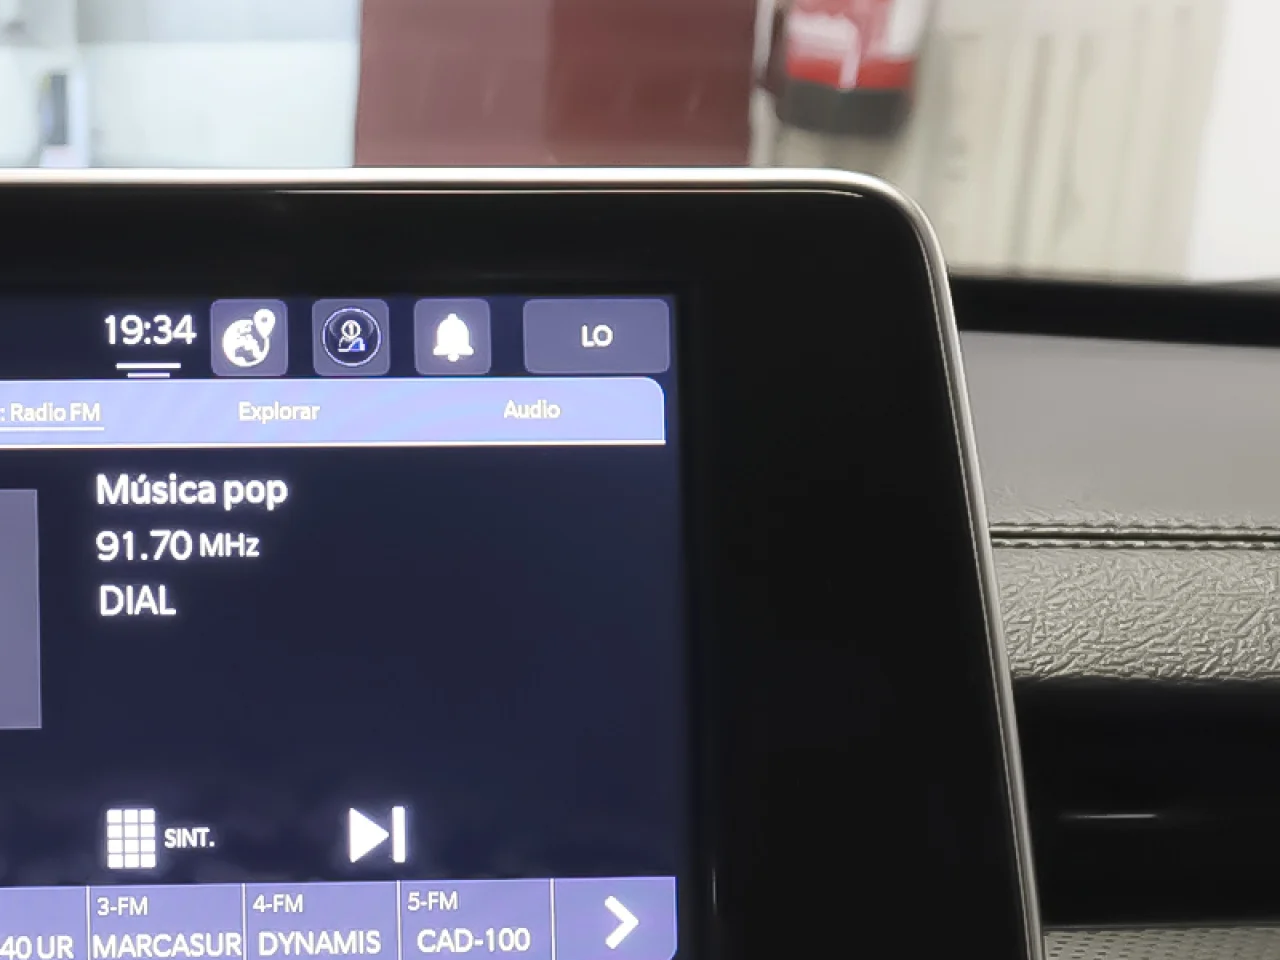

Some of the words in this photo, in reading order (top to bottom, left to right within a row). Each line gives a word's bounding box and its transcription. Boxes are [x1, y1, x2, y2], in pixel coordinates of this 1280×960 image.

[104, 313, 198, 346] 19:34
[581, 325, 614, 348] LO
[10, 403, 66, 422] Radio
[70, 402, 101, 422] FM
[239, 401, 320, 423] Explorar
[503, 400, 561, 419] Audio
[96, 474, 216, 505] Música
[223, 479, 288, 510] pop
[96, 530, 193, 561] 91.70
[199, 534, 260, 558] MHz
[99, 585, 177, 616] DIAL
[164, 828, 215, 849] SINT.
[97, 897, 149, 916] 3-FM
[252, 894, 304, 913] 4-FM
[407, 891, 459, 911] 5-FM
[37, 937, 74, 959] UR
[92, 933, 242, 958] MARCASUR
[259, 931, 381, 955] DYNAMIS
[417, 928, 531, 953] CAD-100
